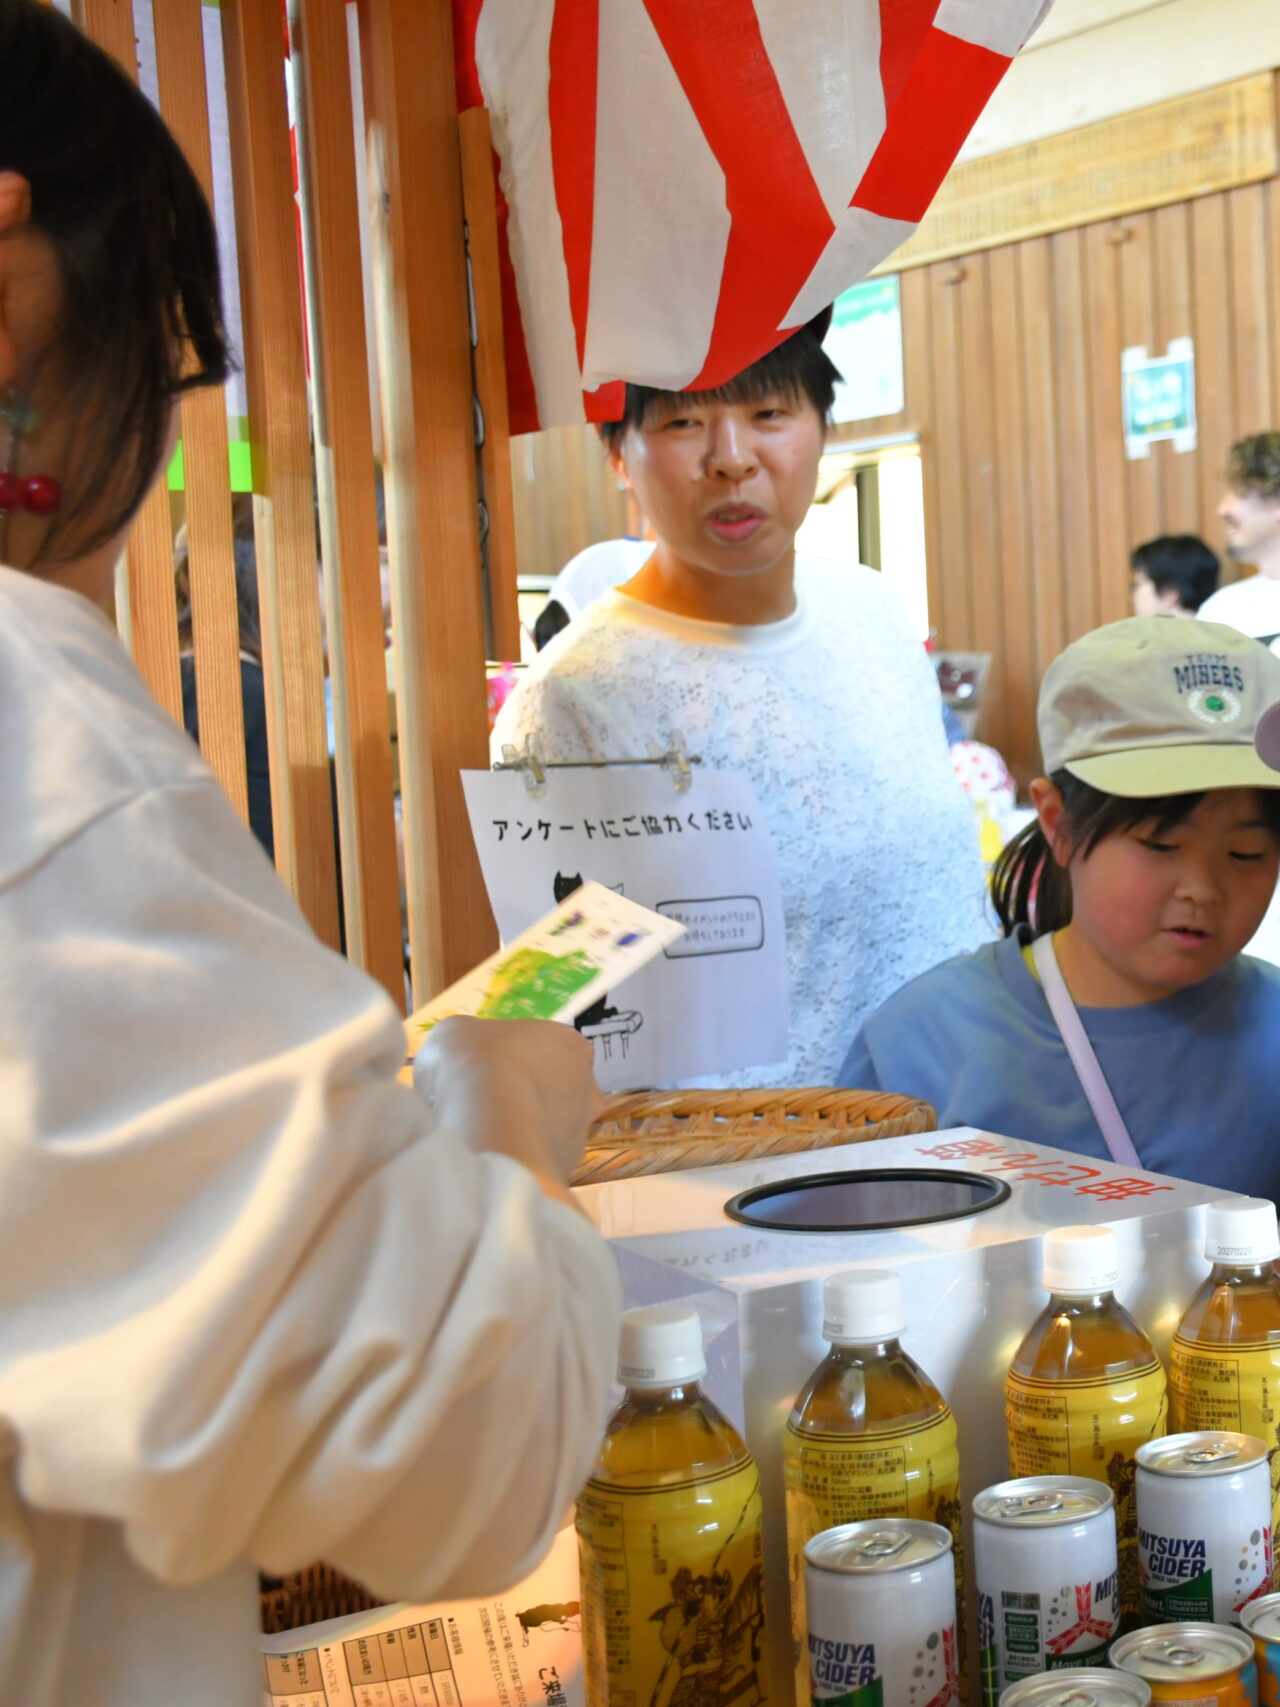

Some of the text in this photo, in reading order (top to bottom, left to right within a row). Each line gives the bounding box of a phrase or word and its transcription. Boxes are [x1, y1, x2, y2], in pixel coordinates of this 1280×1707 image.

[492, 809, 754, 841] アンケートにご協力ください
[1148, 1554, 1206, 1577] CIDER
[538, 1665, 568, 1707] ご来場
[816, 1658, 876, 1685] CIDER
